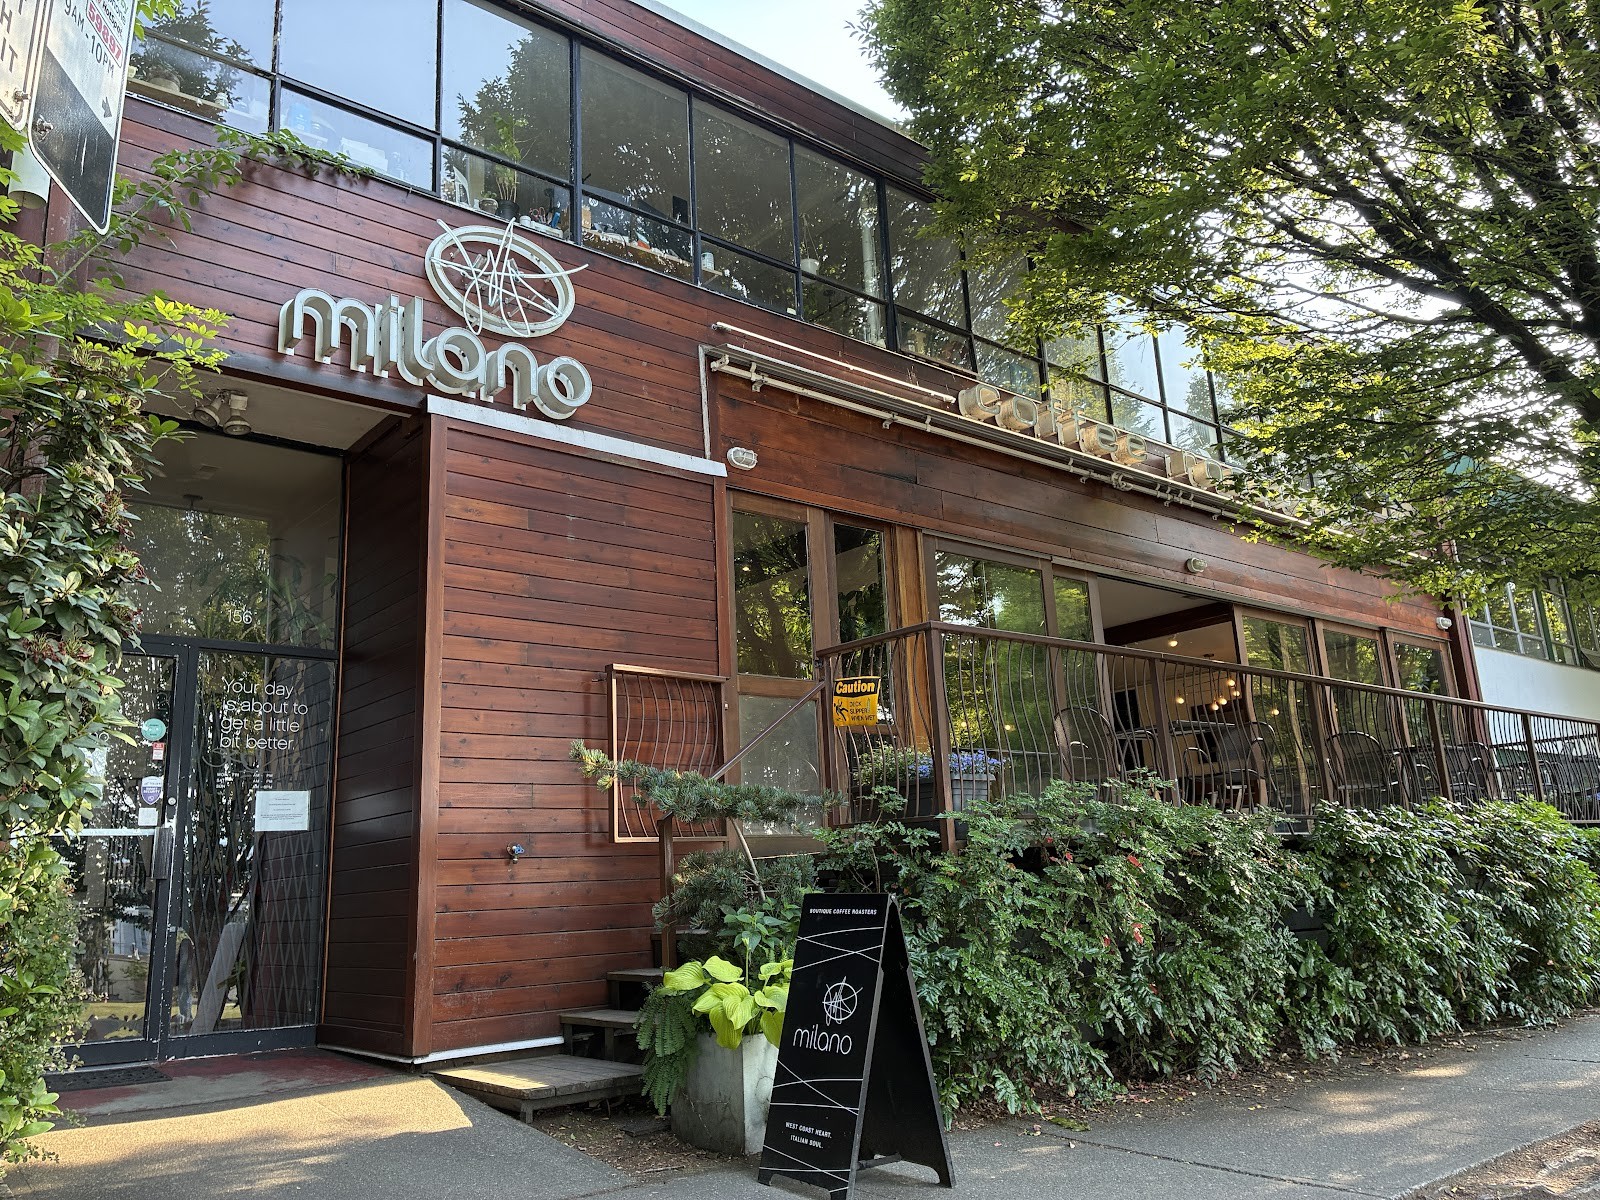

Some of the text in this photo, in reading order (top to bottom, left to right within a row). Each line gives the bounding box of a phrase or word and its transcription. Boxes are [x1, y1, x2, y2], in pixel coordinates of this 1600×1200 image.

[88, 1, 122, 60] 59897
[277, 287, 593, 420] milano
[227, 608, 253, 625] 156
[222, 677, 294, 699] Your day
[836, 680, 875, 694] Caution
[222, 697, 309, 716] is about to
[220, 716, 300, 734] get a little
[219, 732, 295, 751] bit better.
[793, 1024, 852, 1055] milano
[785, 1121, 833, 1139] WEST COAST HEART.
[790, 1134, 824, 1149] ITALIAN SOUL.
